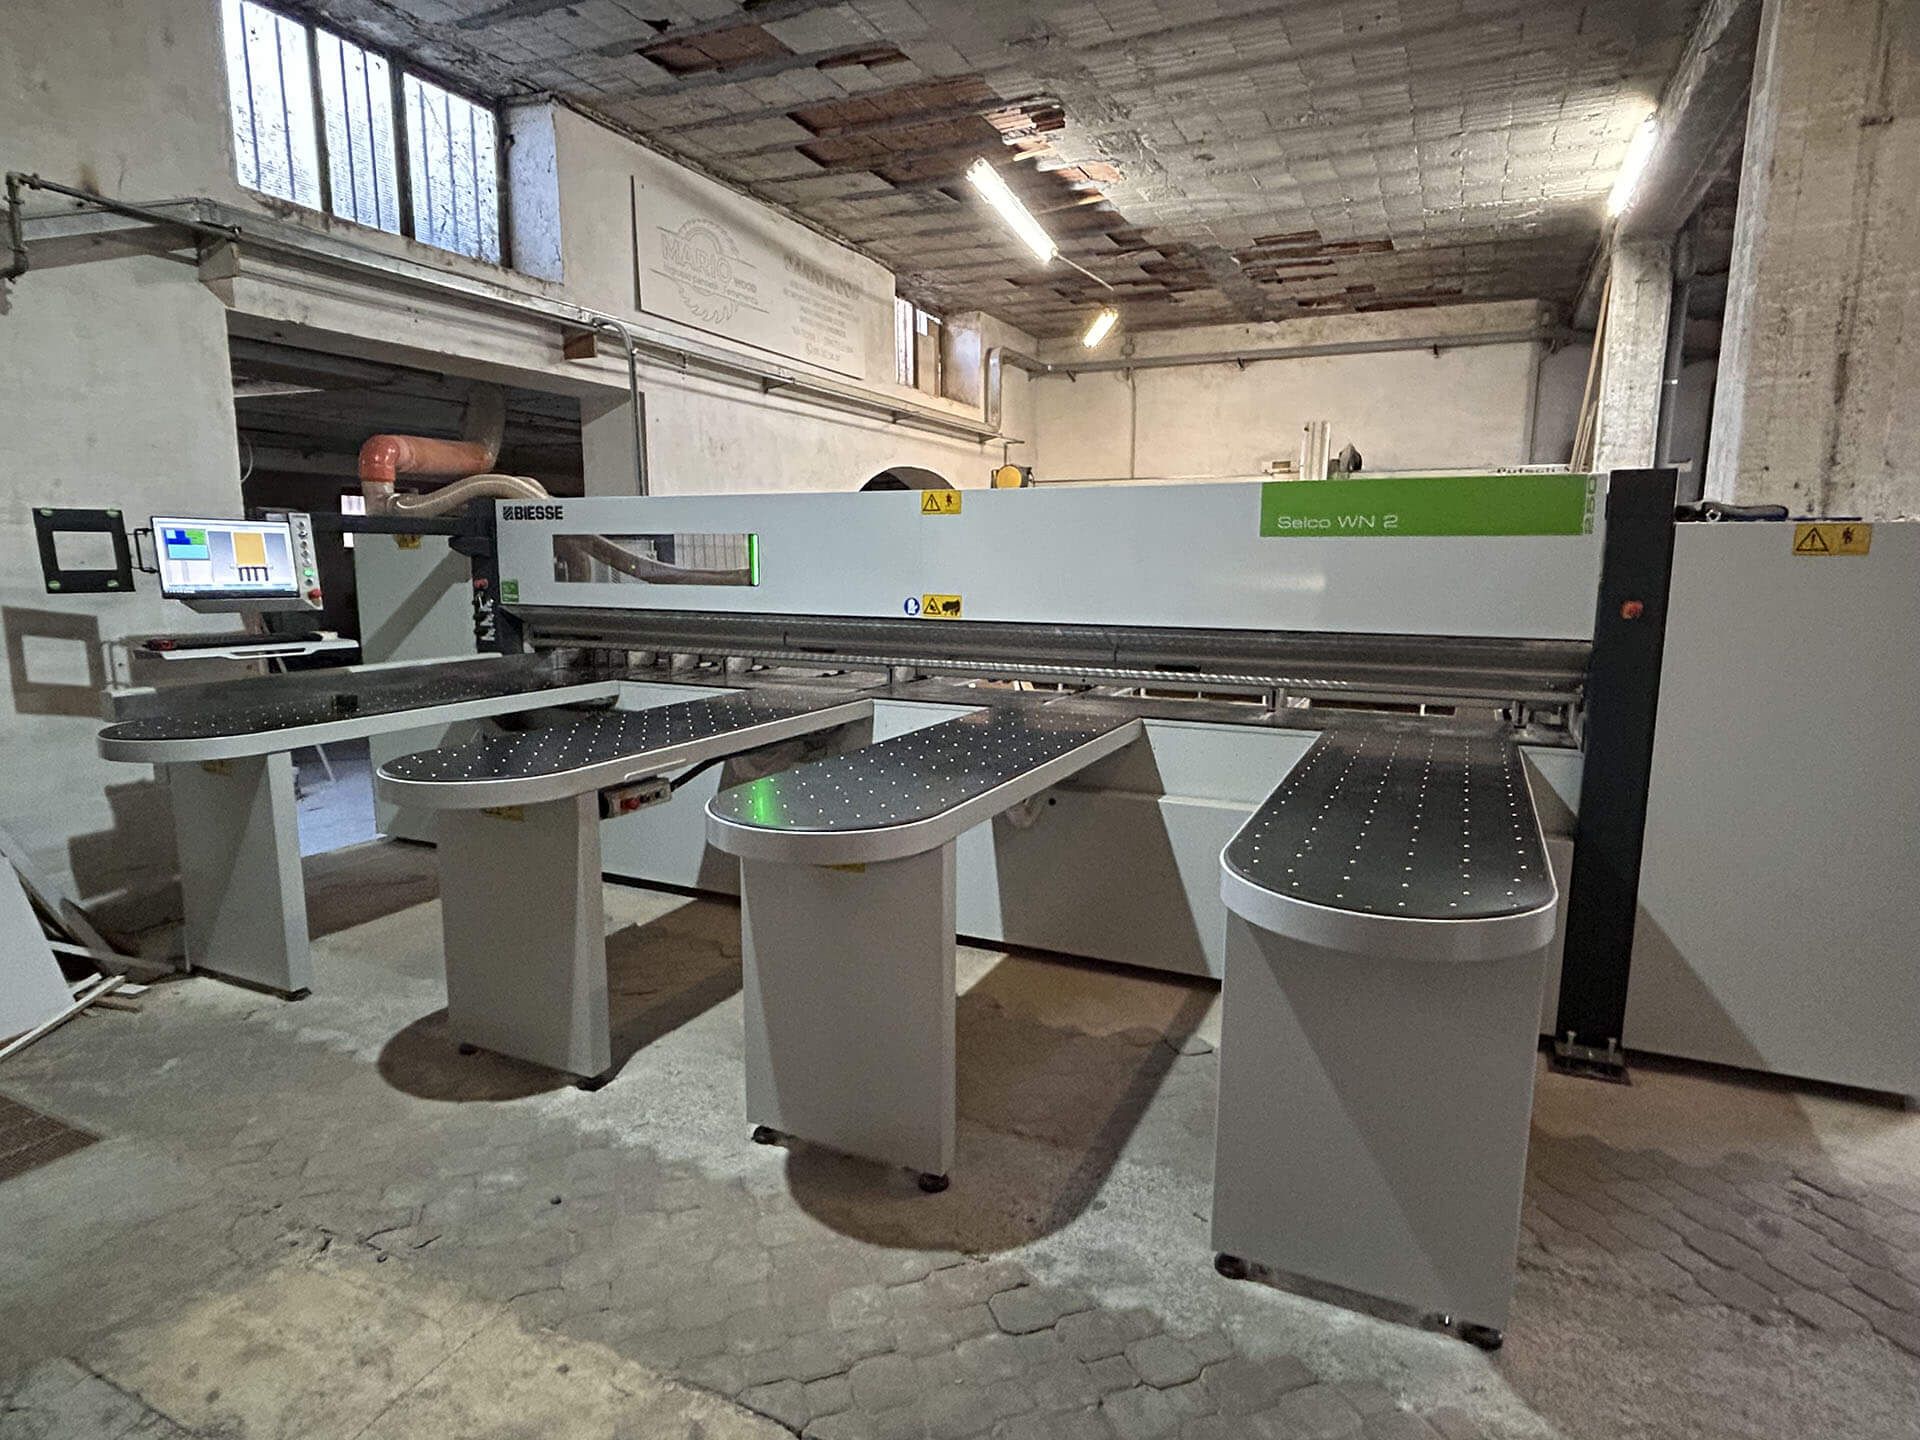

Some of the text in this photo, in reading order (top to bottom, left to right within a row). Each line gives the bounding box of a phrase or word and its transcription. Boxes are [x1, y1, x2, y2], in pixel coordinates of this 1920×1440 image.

[661, 233, 732, 283] MARIO
[514, 505, 563, 520] BIESSE
[1277, 514, 1399, 529] Selco WN 2
